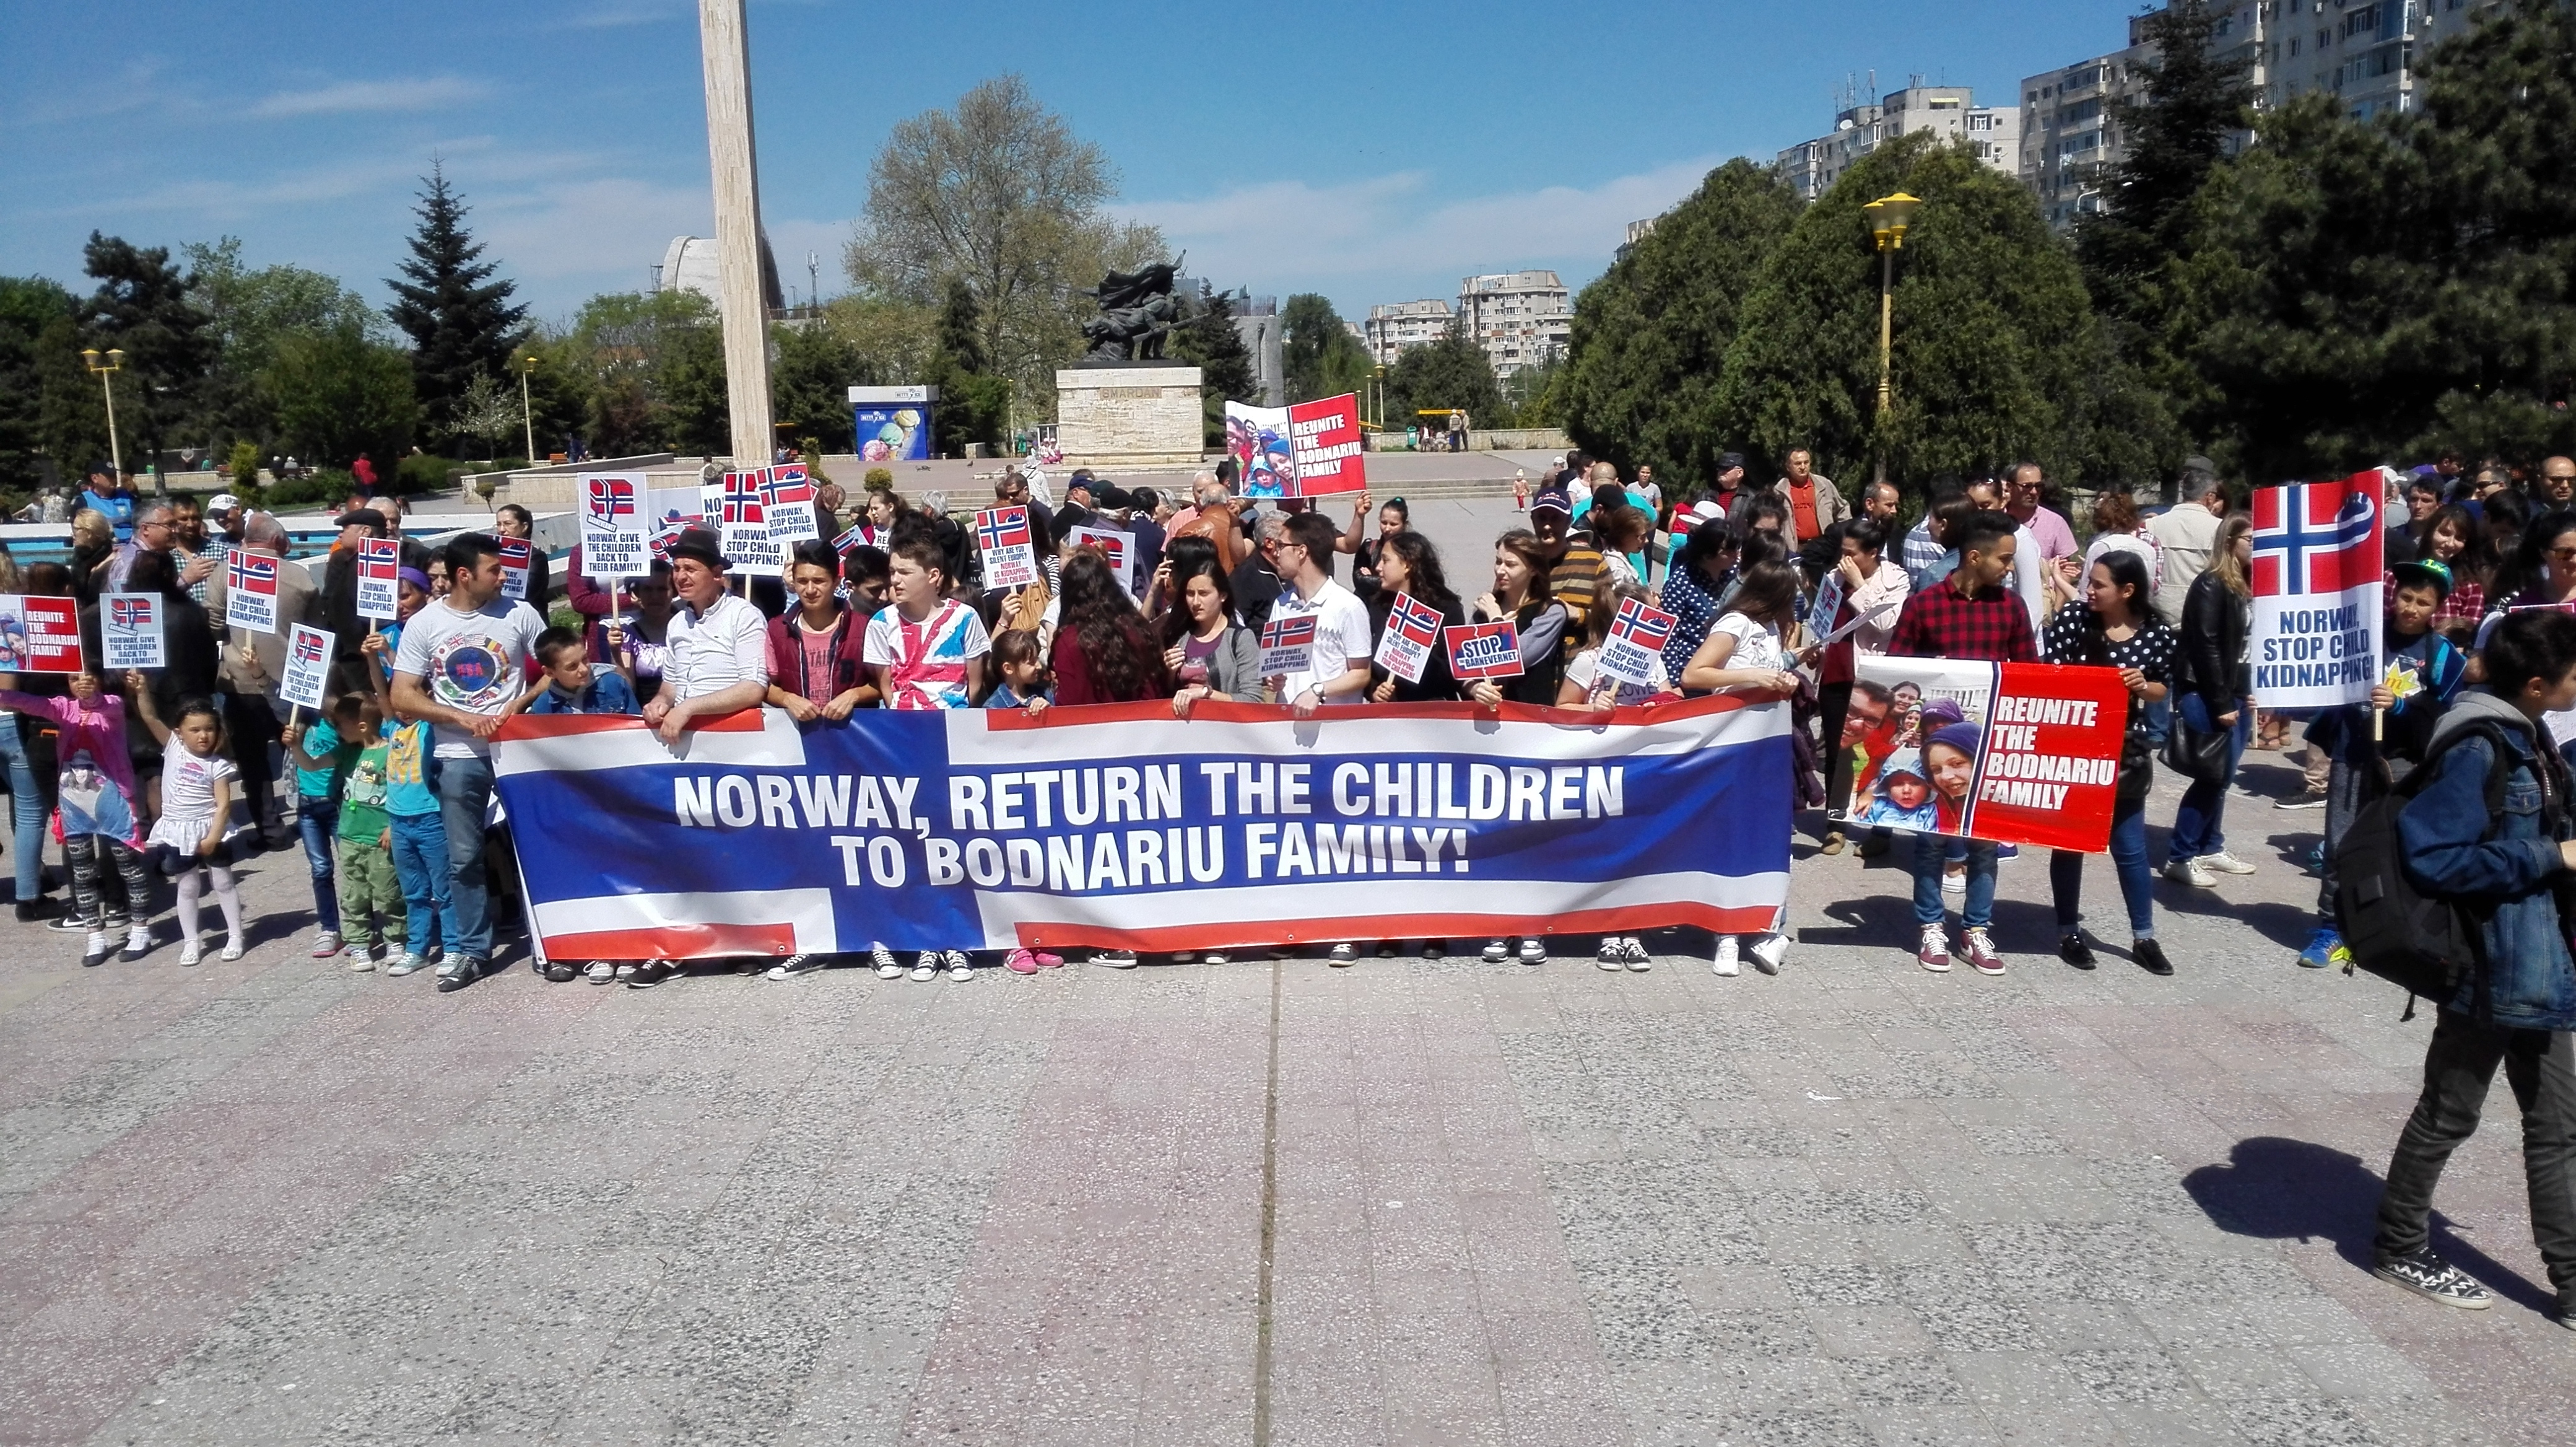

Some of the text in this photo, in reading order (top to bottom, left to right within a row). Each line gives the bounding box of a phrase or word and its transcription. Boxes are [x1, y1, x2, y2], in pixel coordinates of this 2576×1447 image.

[1293, 414, 1344, 435] REUNITE
[1295, 435, 1319, 450] THE
[1297, 441, 1362, 463] BODNARIU
[1299, 460, 1341, 478] FAMILY
[772, 507, 804, 518] NORWAY,
[769, 515, 811, 528] STOP CHILD
[768, 524, 814, 537] KIDNAPPING!
[587, 533, 640, 543] NORWAY, GIVE
[588, 543, 641, 552] THE CHILDREN
[726, 541, 747, 552] STOP
[992, 548, 1004, 556] WHY
[596, 553, 629, 562] BACK TO
[990, 553, 1027, 564] SILENT EUROPE?
[589, 562, 642, 572] THEIR FAMILY!
[1001, 561, 1021, 569] NORWAY
[1001, 567, 1029, 577] KIDNAPPING
[1009, 574, 1032, 584] CHILDREN!
[363, 582, 387, 593] NORWAY,
[236, 593, 266, 607] NORWAY,
[360, 591, 392, 602] STOP CHILD
[232, 601, 270, 616] STOP CHILD
[359, 600, 394, 612] KIDNAPPING!
[26, 611, 64, 623] REUNITE
[229, 610, 272, 626] KIDNAPPING!
[27, 623, 45, 633] THE
[29, 634, 77, 645] BODNARIU
[2264, 629, 2369, 662] STOP CHILD
[31, 645, 63, 656] FAMILY
[1270, 648, 1302, 657] NORWAY,
[1463, 637, 1499, 658] STOP
[1615, 642, 1648, 660] NORWAY,
[1285, 654, 1307, 662] CHILD
[1465, 652, 1516, 667] BARNEVERNET
[1606, 649, 1650, 670] STOP CHILD
[1261, 660, 1308, 672] KIDNAPPING!
[1599, 655, 1648, 679] KIDNAPPING!
[2256, 655, 2375, 688] KIDNAPPING!
[295, 678, 319, 690] CHILDREN
[307, 675, 320, 683] GIVE
[290, 684, 301, 693] BACK
[296, 694, 316, 704] FAMILY!
[1996, 696, 2099, 727] REUNITE
[1994, 724, 2039, 750] THE
[1986, 752, 2116, 786] BODNARIU
[673, 762, 1624, 839] NORWAY, RETURN THE CHILDREN
[1980, 779, 2069, 810] FAMILY
[831, 823, 1469, 891] TO BODNARIU FAMILY!
